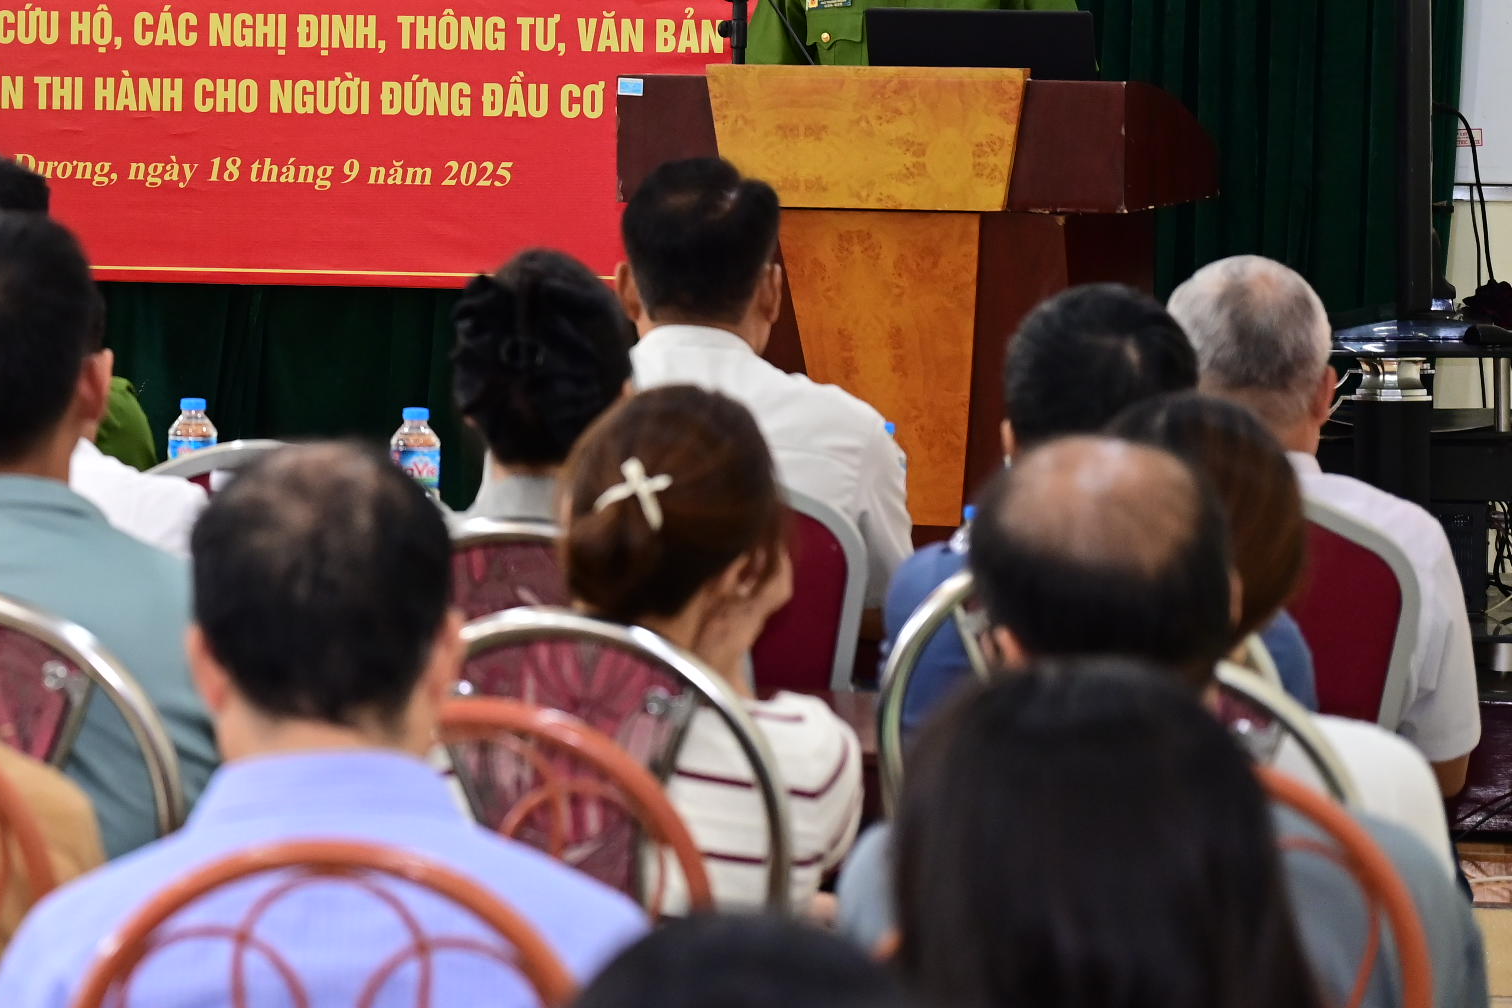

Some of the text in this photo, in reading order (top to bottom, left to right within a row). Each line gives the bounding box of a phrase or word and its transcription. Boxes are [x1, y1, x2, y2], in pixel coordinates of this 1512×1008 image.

[70, 3, 123, 53] HỘ,
[133, 5, 198, 47] CÁC
[209, 12, 287, 56] NGHỊ
[296, 13, 386, 56] ĐỊNH,
[396, 8, 506, 51] THÔNG
[516, 13, 566, 56] TƯ,
[577, 10, 644, 53] VĂN
[655, 7, 724, 54] BẢN
[33, 76, 83, 111] THI
[94, 70, 183, 112] HÀNH
[194, 78, 258, 113] CHO
[269, 71, 370, 115] NGƯỜI
[380, 74, 471, 117] ĐỨNG
[481, 71, 551, 118] ĐẦU
[560, 80, 606, 119] CƠ
[127, 156, 199, 189] ngày
[208, 156, 242, 182] 18
[250, 157, 335, 191] tháng
[342, 158, 360, 184] 9
[367, 160, 432, 185] năm
[441, 160, 514, 187] 2025
